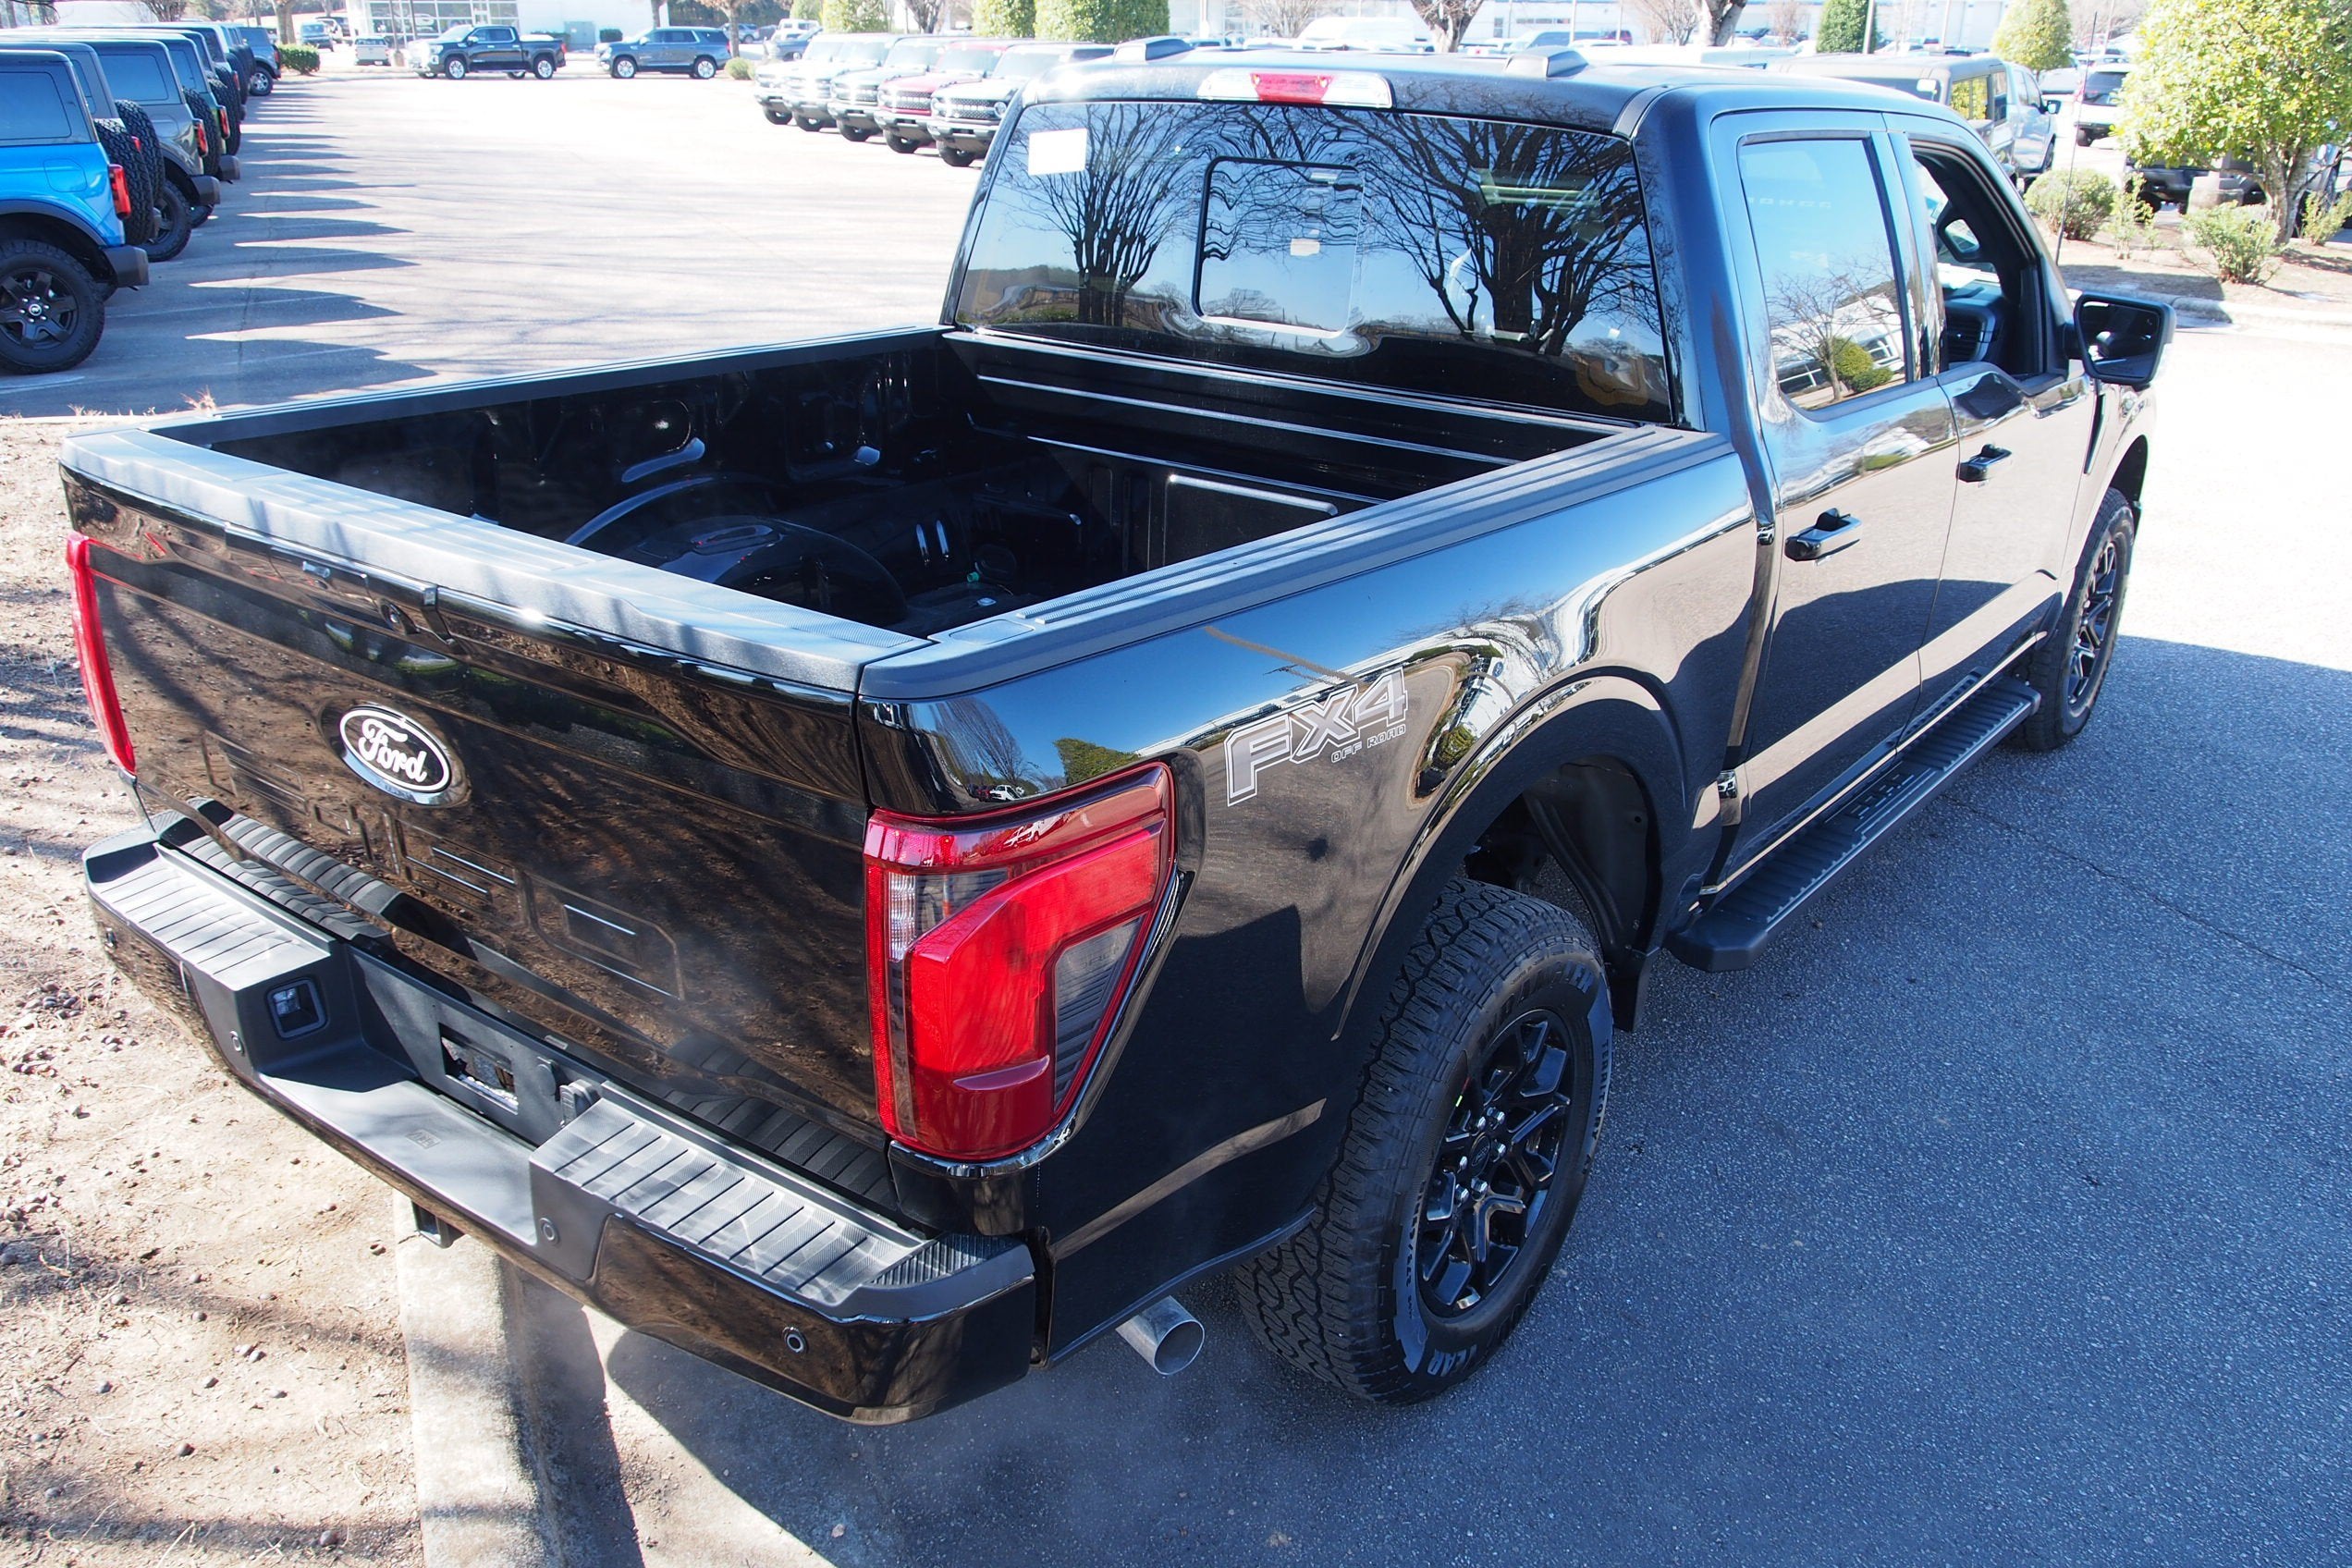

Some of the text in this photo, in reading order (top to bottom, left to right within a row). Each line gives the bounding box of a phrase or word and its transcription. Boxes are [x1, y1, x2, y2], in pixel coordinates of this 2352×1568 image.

[358, 718, 427, 782] Ford
[1224, 666, 1408, 807] FX4
[1331, 724, 1406, 764] OFF ROAD
[1591, 1037, 1610, 1141] TERRITORY
